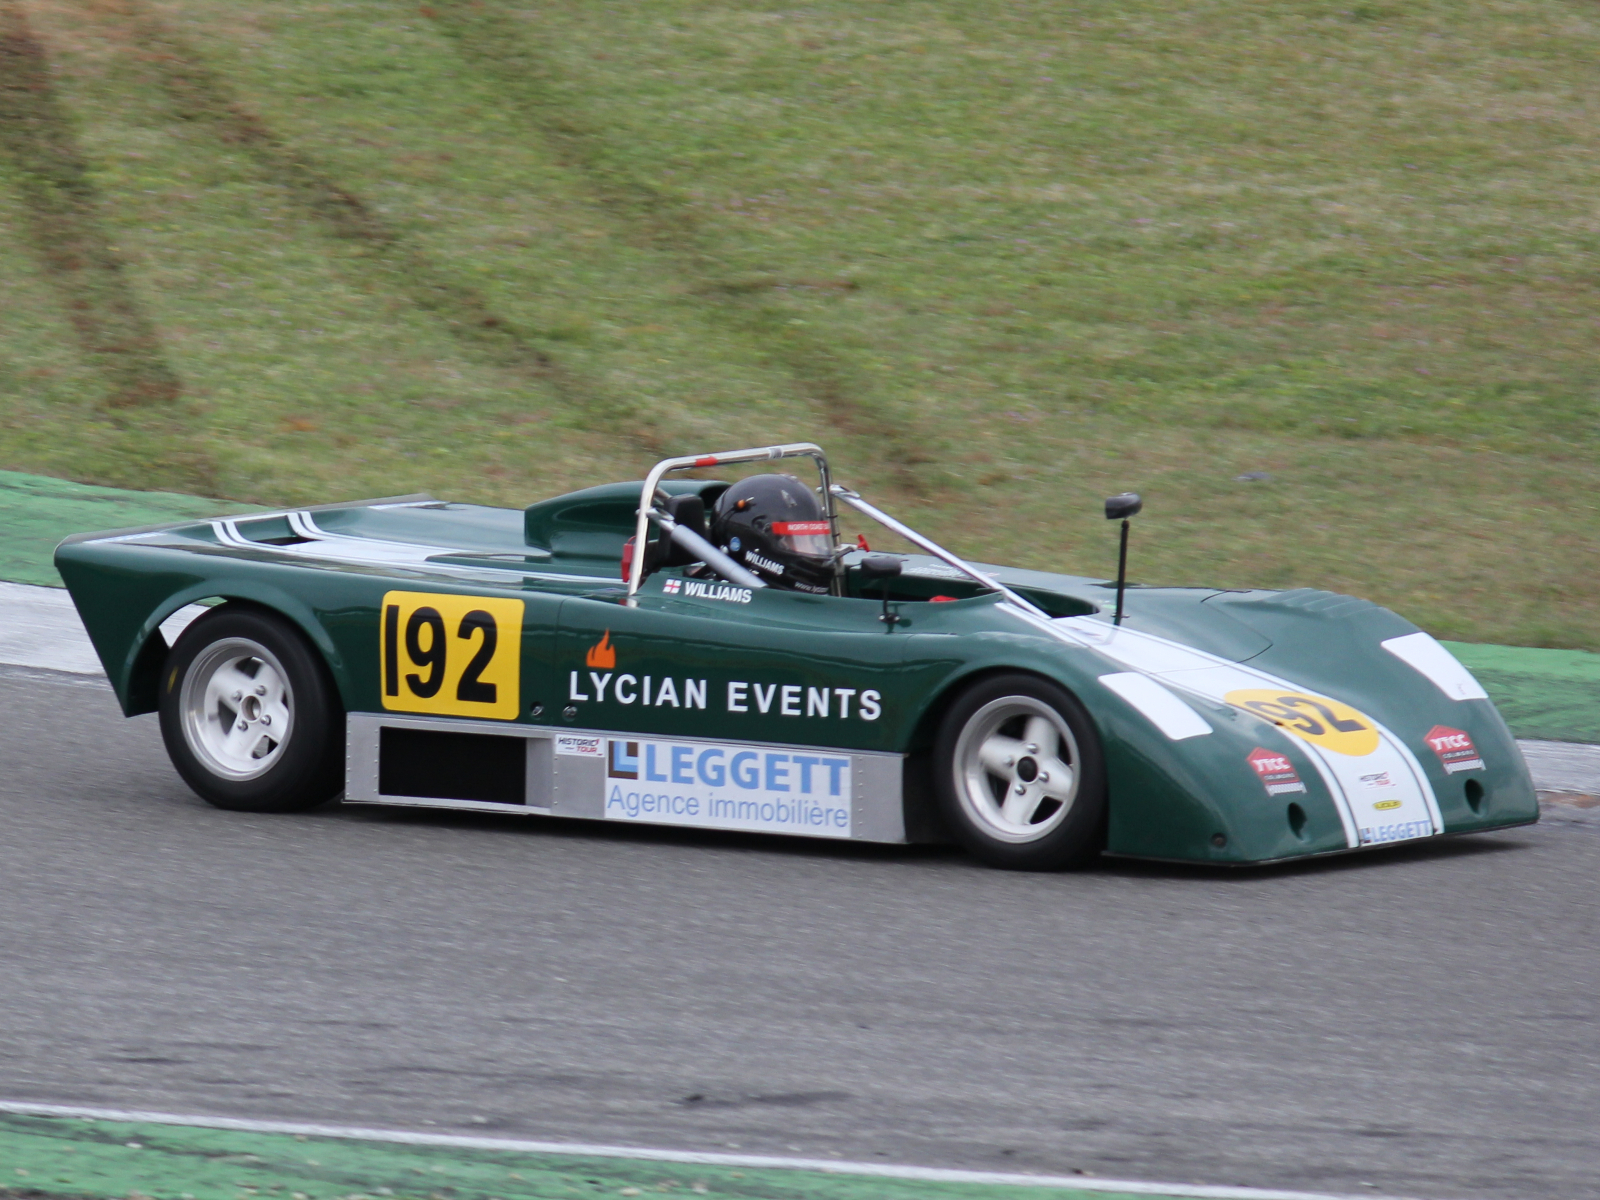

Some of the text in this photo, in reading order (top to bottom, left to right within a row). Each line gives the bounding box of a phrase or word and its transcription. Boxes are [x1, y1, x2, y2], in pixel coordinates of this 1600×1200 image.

[744, 551, 785, 575] WILLIAMS
[684, 581, 752, 604] WILLIAMS
[385, 605, 497, 703] 192
[570, 671, 881, 722] LYCIAN EVENTS
[558, 737, 598, 747] HISTORIC
[1430, 734, 1470, 751] YTCC
[645, 743, 850, 797] LEGGETT
[1252, 758, 1291, 772] YTCC
[607, 787, 848, 828] Agence immobilière
[1374, 820, 1430, 842] LEGGETT
